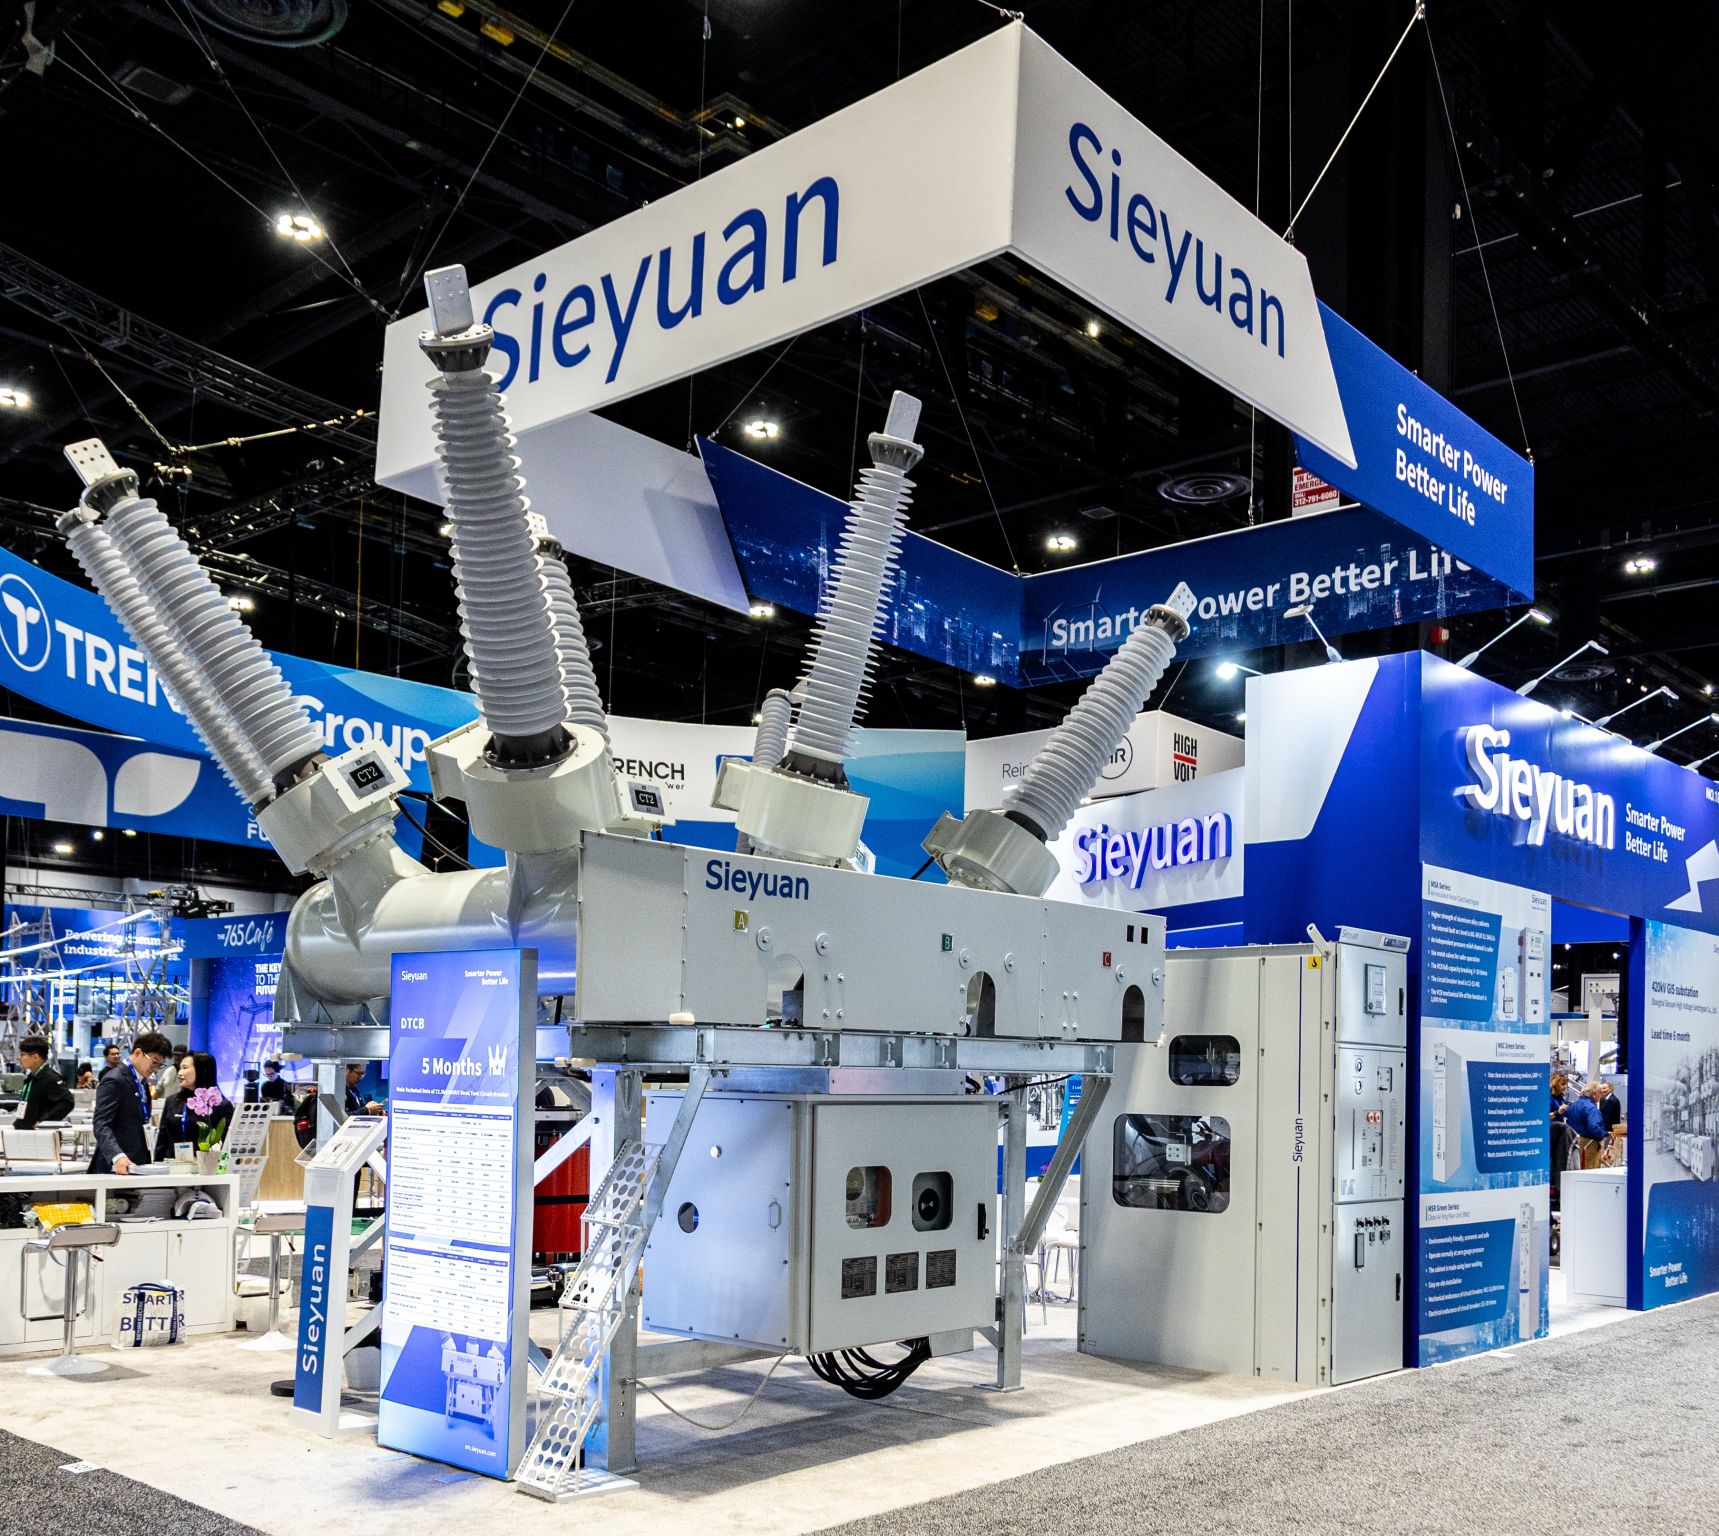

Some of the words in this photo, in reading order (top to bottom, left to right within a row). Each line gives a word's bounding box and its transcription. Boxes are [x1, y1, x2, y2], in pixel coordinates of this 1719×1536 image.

[1065, 122, 1285, 358] Sieyuan
[483, 176, 840, 393] Sieyuan
[1396, 403, 1460, 472] Smarter
[1464, 449, 1508, 504] Power
[1396, 448, 1445, 506] Better
[1448, 483, 1475, 526] Life
[1294, 490, 1337, 506] 312-791-6060
[1051, 608, 1151, 647] Smarte
[1198, 582, 1280, 619] ower
[1290, 557, 1399, 602] Better
[1174, 732, 1197, 757] HIGH
[356, 766, 378, 784] CT2
[613, 757, 685, 780] RENCH
[1454, 724, 1615, 850] Sieyuan
[638, 794, 655, 805] CT2
[1626, 803, 1659, 832] Smarter
[1661, 816, 1685, 841] Power
[1072, 810, 1232, 889] Sieyuan
[1626, 831, 1651, 857] Better
[1653, 840, 1668, 863] Life
[706, 859, 809, 901] Sieyuan
[1532, 894, 1547, 906] Sieyuan
[738, 914, 745, 929] A
[64, 929, 124, 946] Powering
[224, 924, 244, 948] 765
[244, 920, 274, 952] Café
[944, 936, 951, 950] B
[255, 964, 268, 974] THE
[1104, 954, 1110, 966] C
[255, 974, 265, 985] TO
[401, 970, 427, 983] Sieyuan
[1667, 984, 1675, 994] GIS
[1676, 985, 1698, 998] substation
[401, 1018, 424, 1029] DTCB
[1651, 1029, 1662, 1039] Lead
[1662, 1029, 1672, 1040] time
[1677, 1032, 1690, 1042] month
[422, 1057, 430, 1074] 5
[433, 1057, 482, 1076] Months
[1292, 1118, 1305, 1162] Sieyuan
[1650, 1265, 1668, 1277] Smarter
[1668, 1262, 1682, 1272] Power
[1665, 1276, 1679, 1287] Better
[1679, 1272, 1688, 1284] Life
[303, 1244, 326, 1374] Sieyuan
